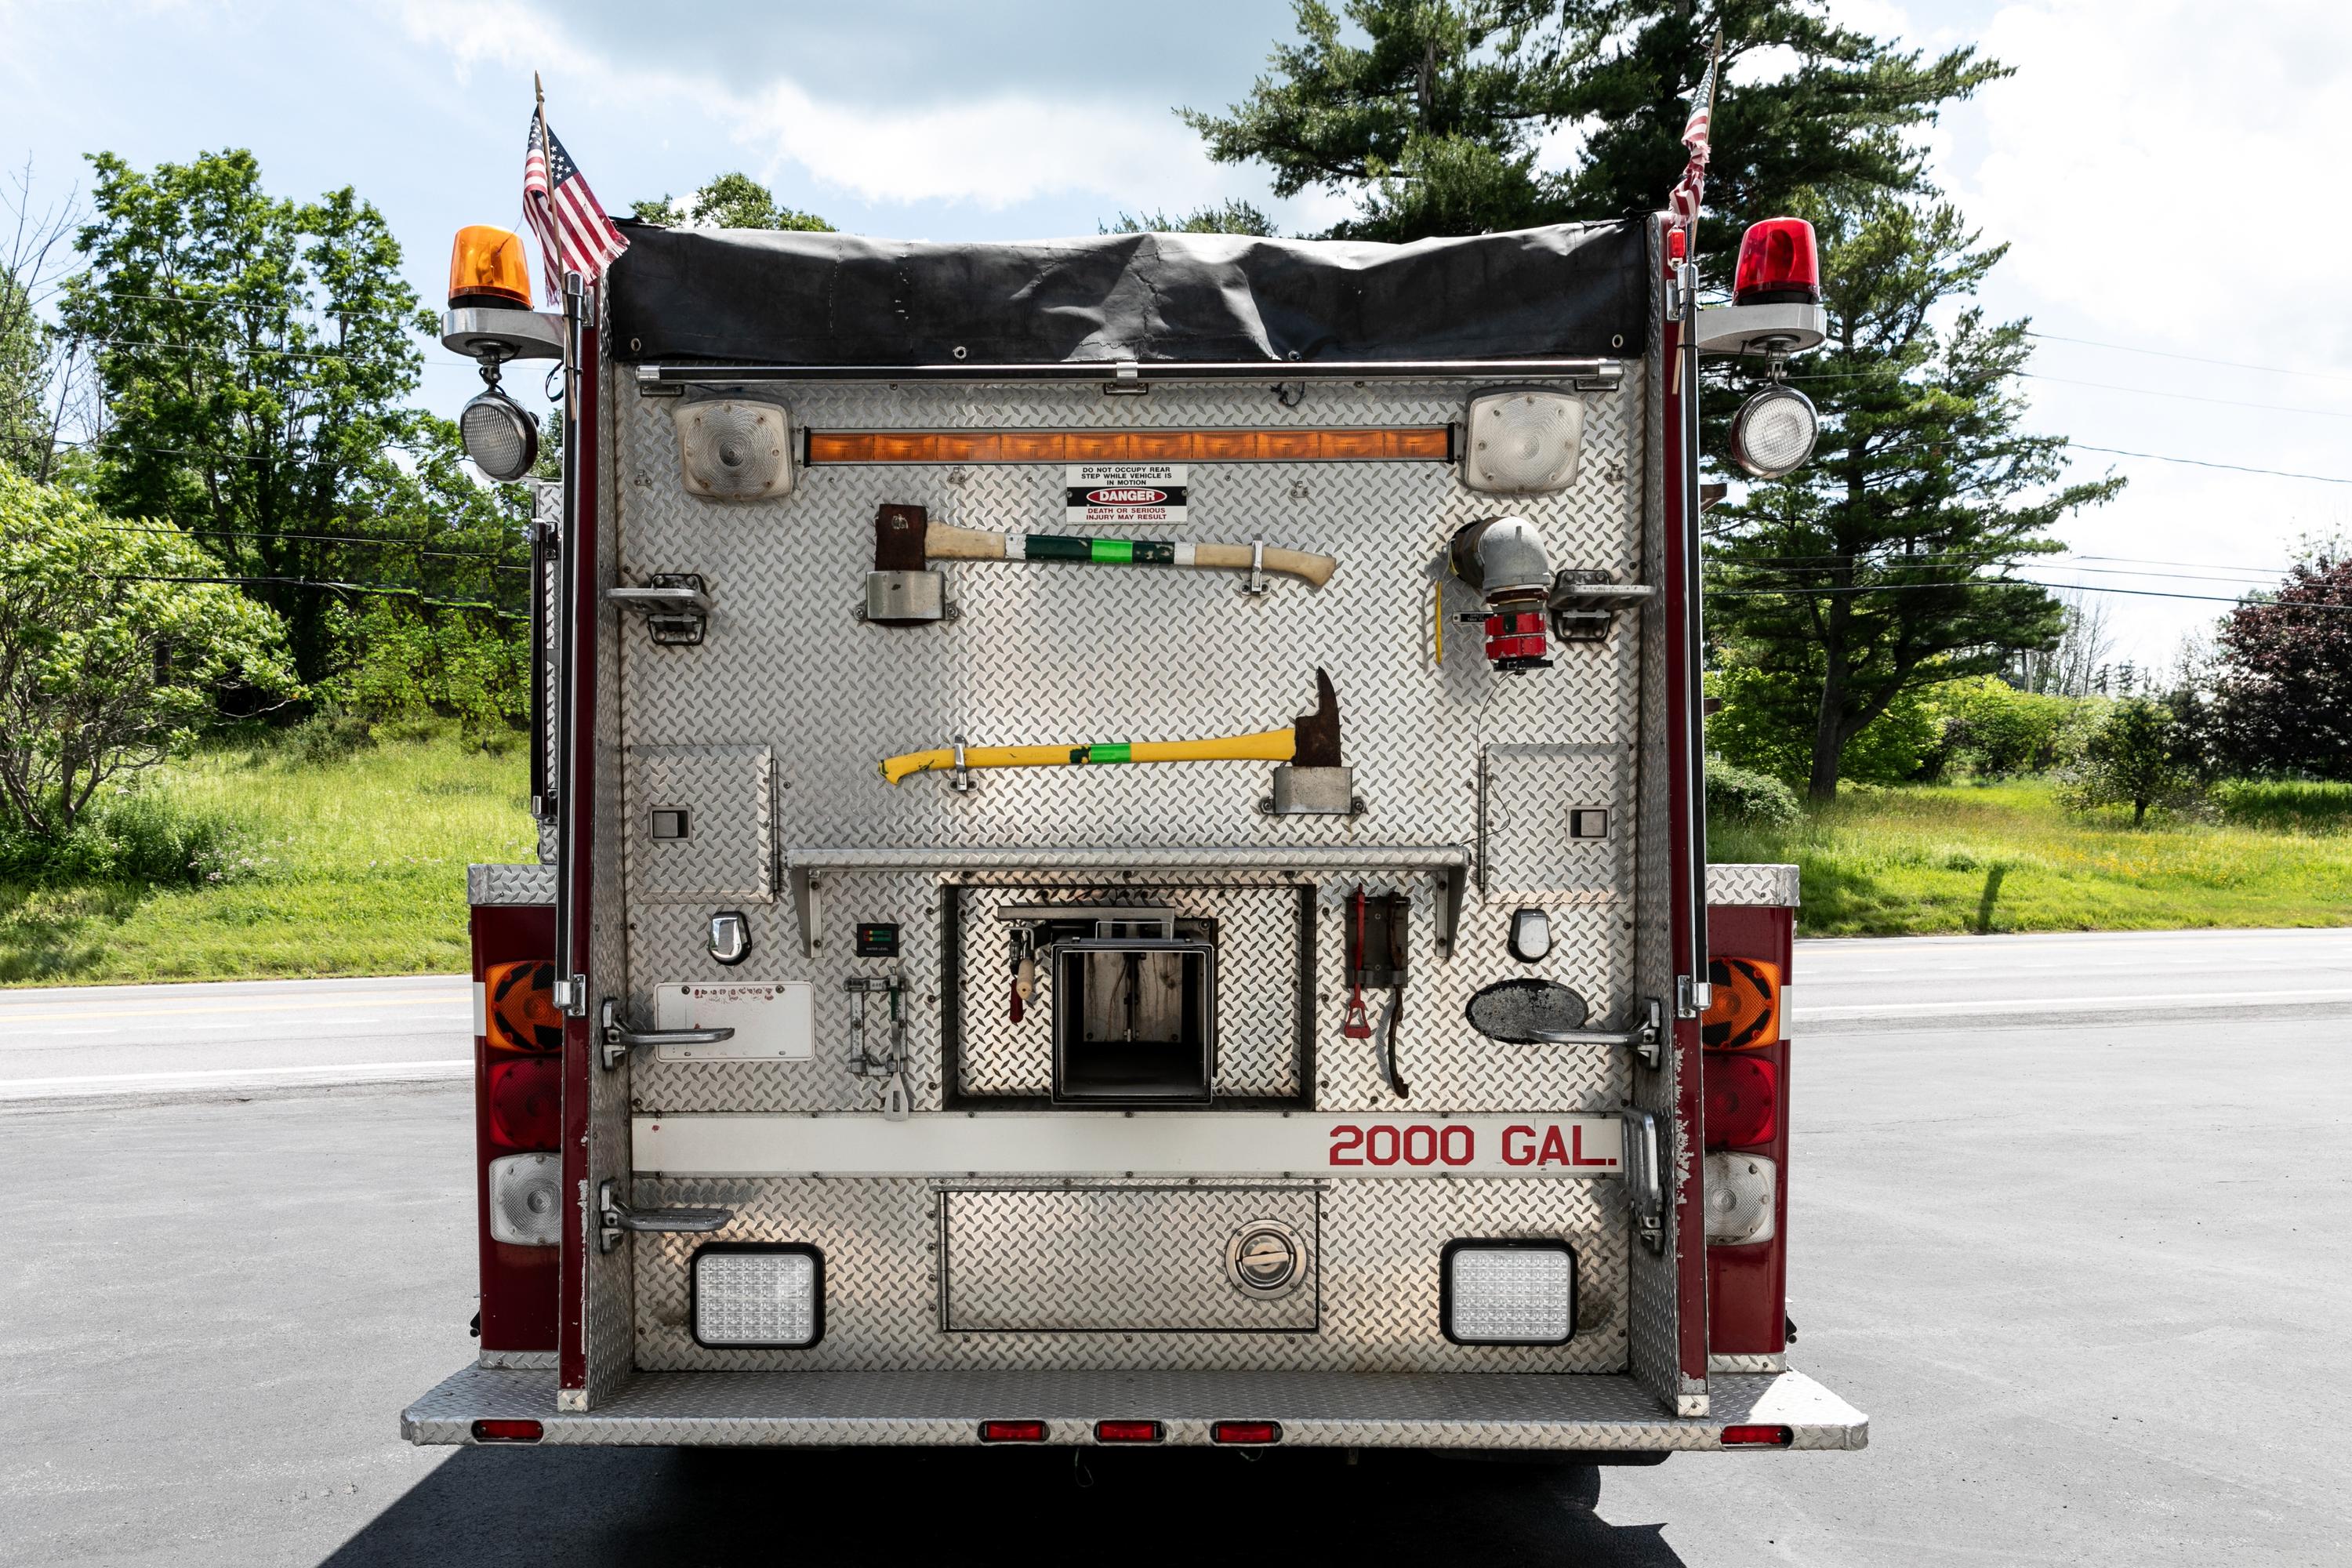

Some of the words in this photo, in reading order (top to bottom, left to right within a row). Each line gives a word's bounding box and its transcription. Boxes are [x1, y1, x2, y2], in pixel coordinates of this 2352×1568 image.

[1099, 490, 1156, 501] DANGER
[1330, 1125, 1474, 1166] 2000
[1501, 1125, 1617, 1166] GAL.
